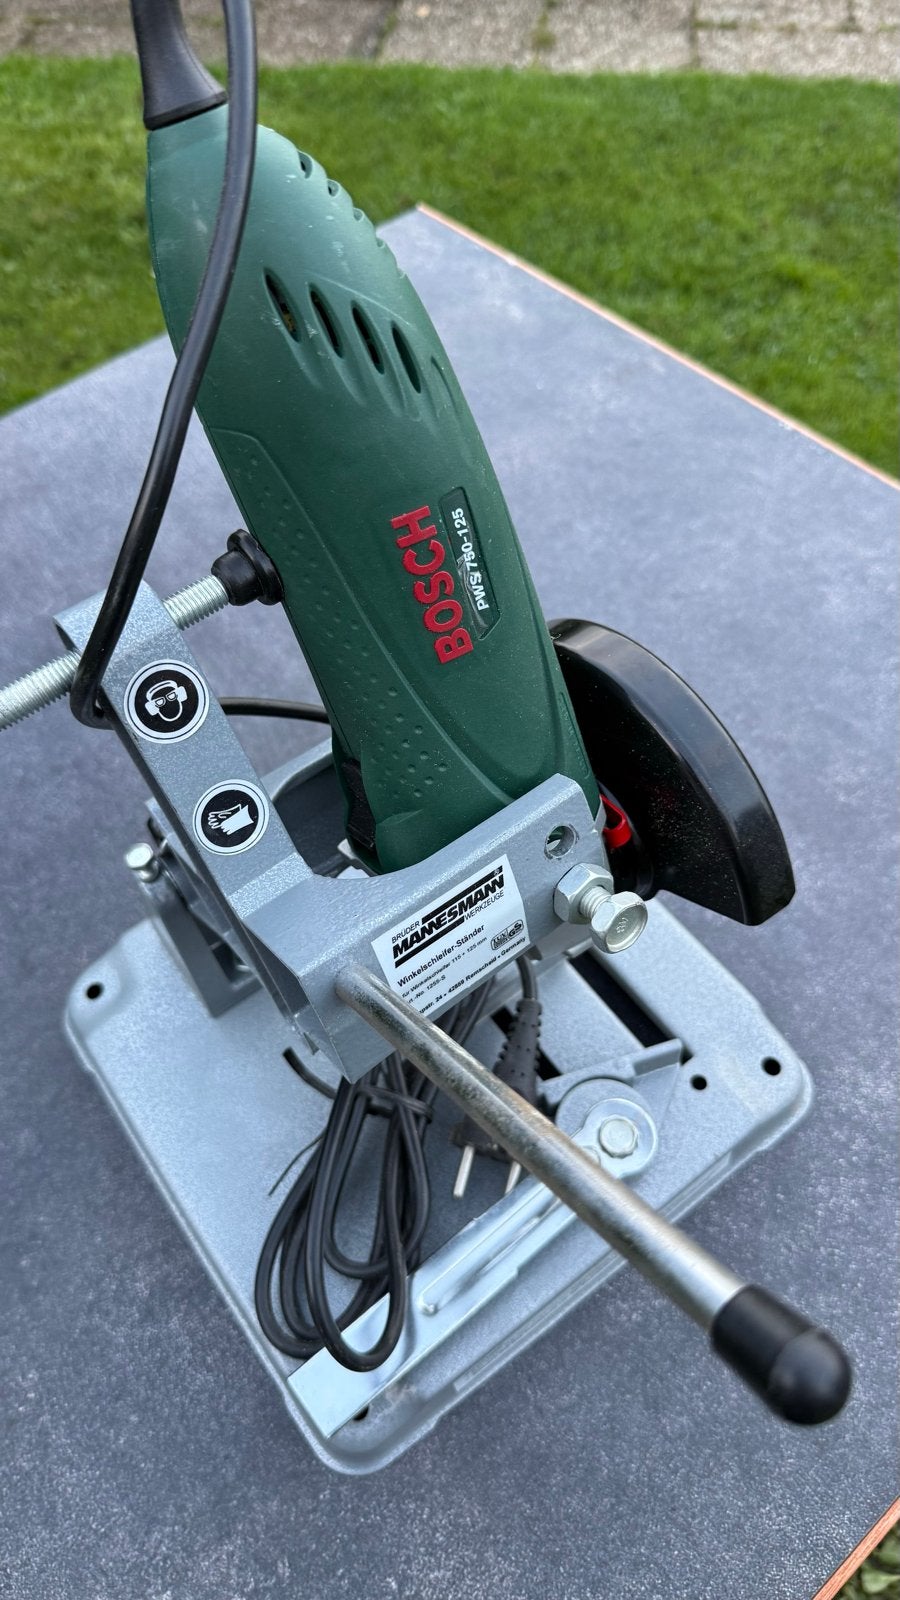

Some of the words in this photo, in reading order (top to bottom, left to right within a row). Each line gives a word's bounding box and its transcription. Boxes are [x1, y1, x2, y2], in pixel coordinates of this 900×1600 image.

[451, 507, 478, 571] 750-125
[390, 505, 474, 664] BOSCH
[469, 571, 490, 611] PWS
[392, 920, 420, 944] BRÜDER
[393, 874, 504, 959] MANNESMANN
[464, 890, 504, 921] WERKZEUGE
[508, 922, 522, 938] GS
[397, 925, 485, 987] Winkelschleifer-Ständer
[410, 962, 451, 992] Winkelschleifer
[451, 955, 462, 963] 115
[466, 944, 477, 953] 125
[476, 937, 488, 946] mm
[435, 994, 443, 1003] 24
[448, 979, 465, 993] 42859
[465, 956, 497, 981] Remscheid
[500, 936, 526, 956] Germany
